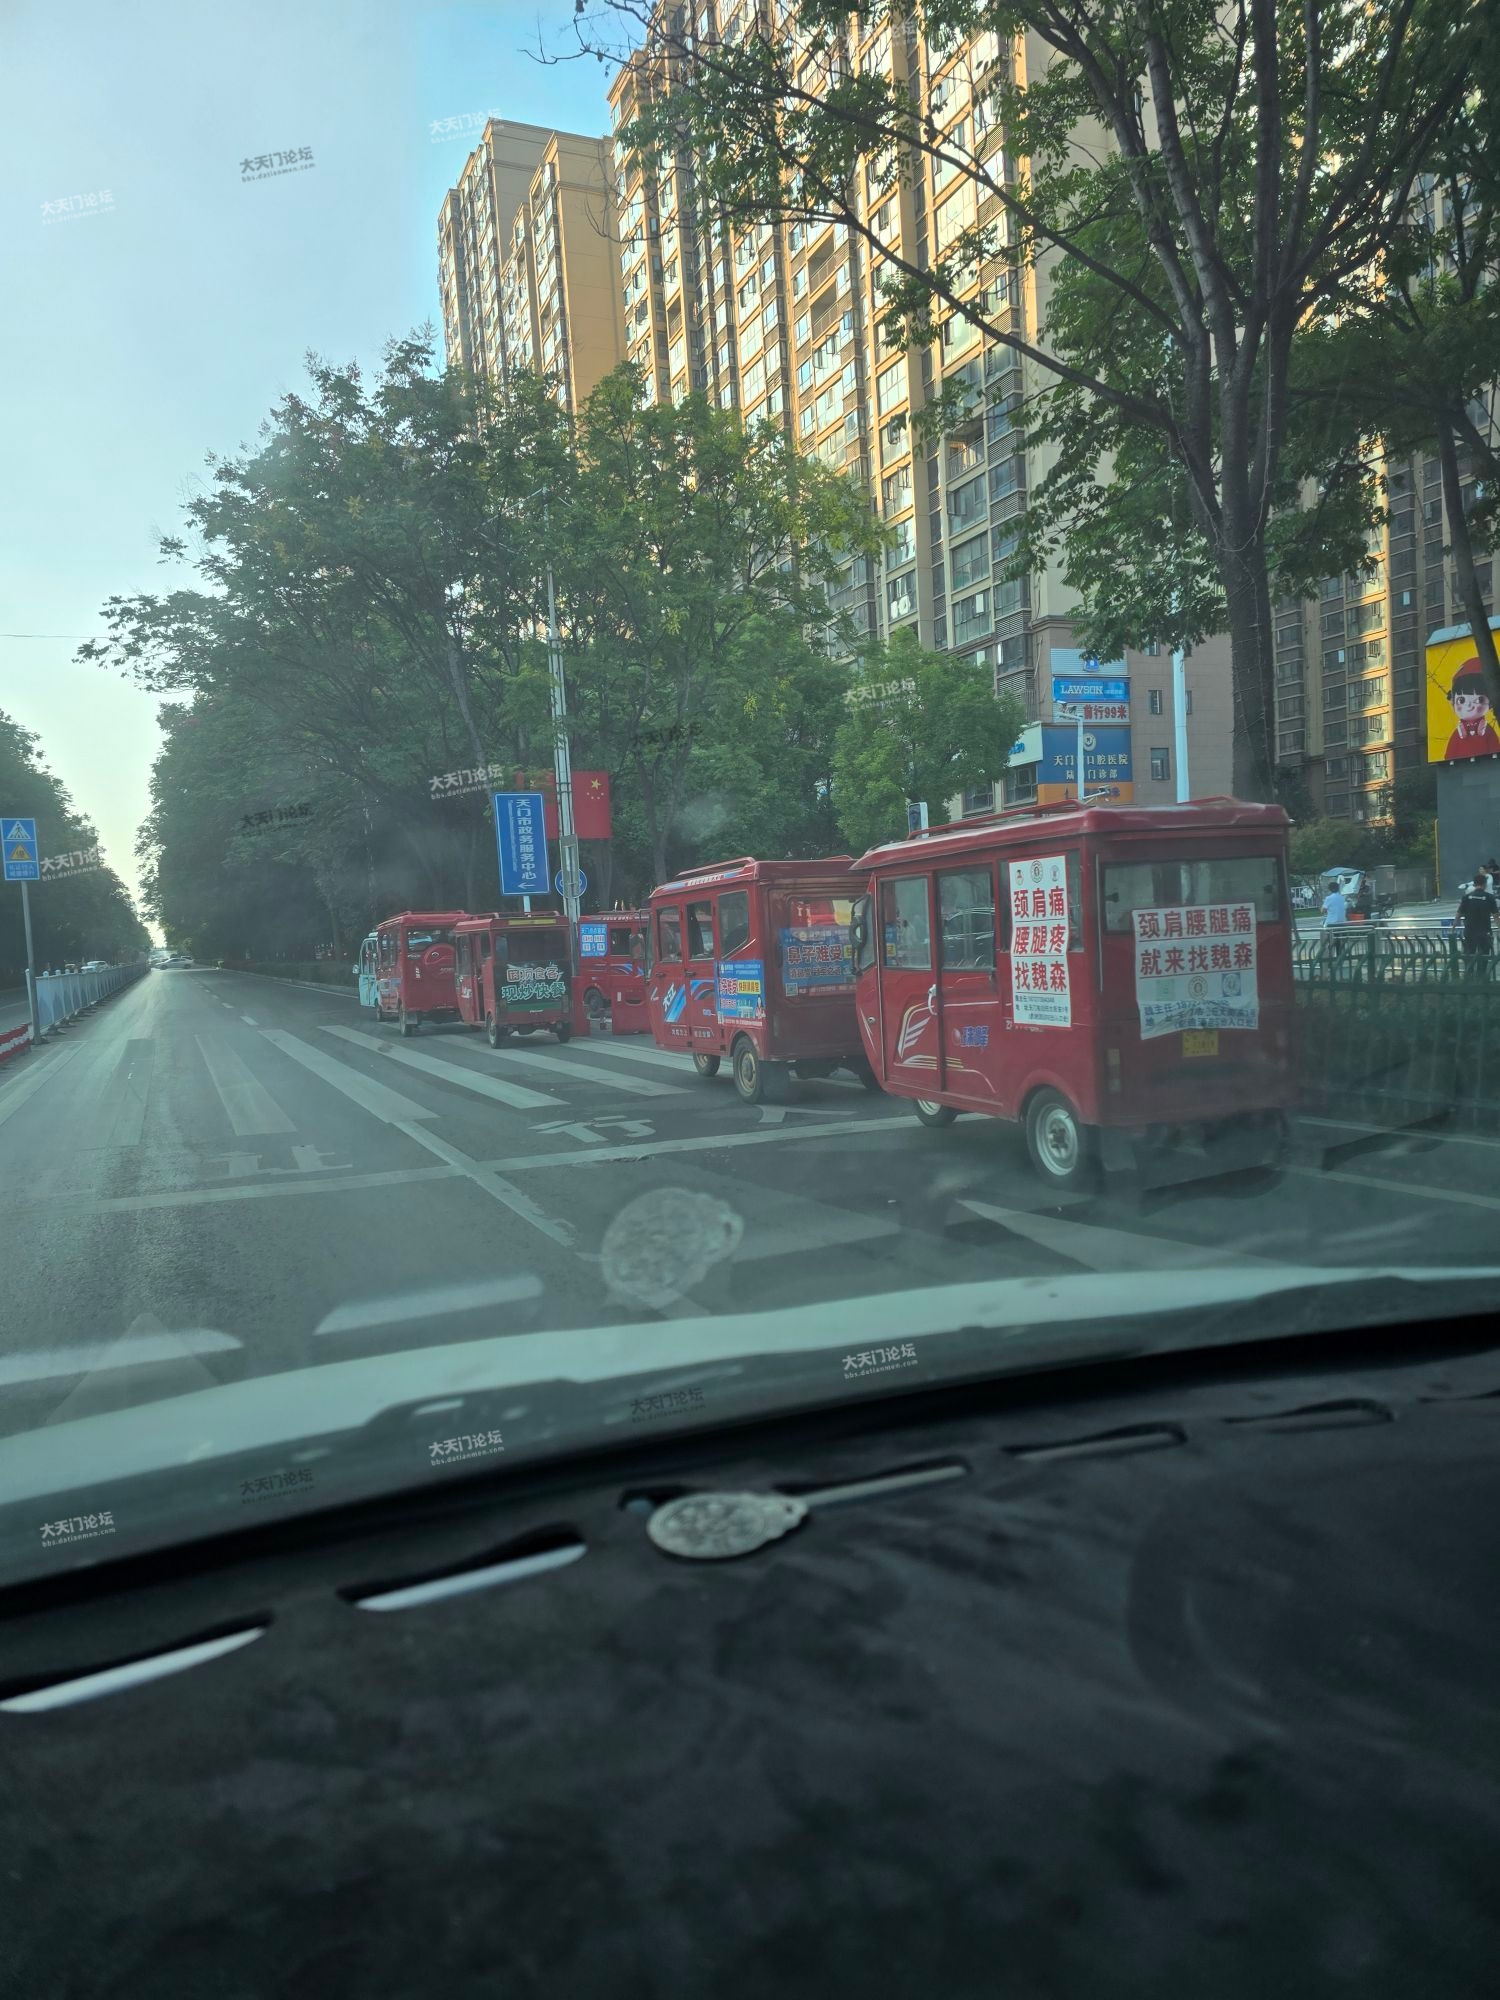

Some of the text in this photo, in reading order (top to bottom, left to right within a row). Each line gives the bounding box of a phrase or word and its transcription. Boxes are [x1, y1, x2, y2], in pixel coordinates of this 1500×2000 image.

[1060, 685, 1104, 695] LAWSON
[1053, 754, 1129, 766] 天门口腔医院
[1066, 769, 1118, 780] 陆门诊部
[516, 799, 537, 880] 天门市政务服务中心
[1013, 885, 1065, 918] 颈肩痛
[1137, 906, 1254, 938] 颈肩腰腿痛
[787, 943, 843, 964] 鼻子难受
[1013, 924, 1066, 955] 腰腿疼
[1139, 942, 1254, 975] 就来找魏森
[502, 981, 566, 1002] 现炒快餐
[1015, 961, 1067, 992] 找魏森
